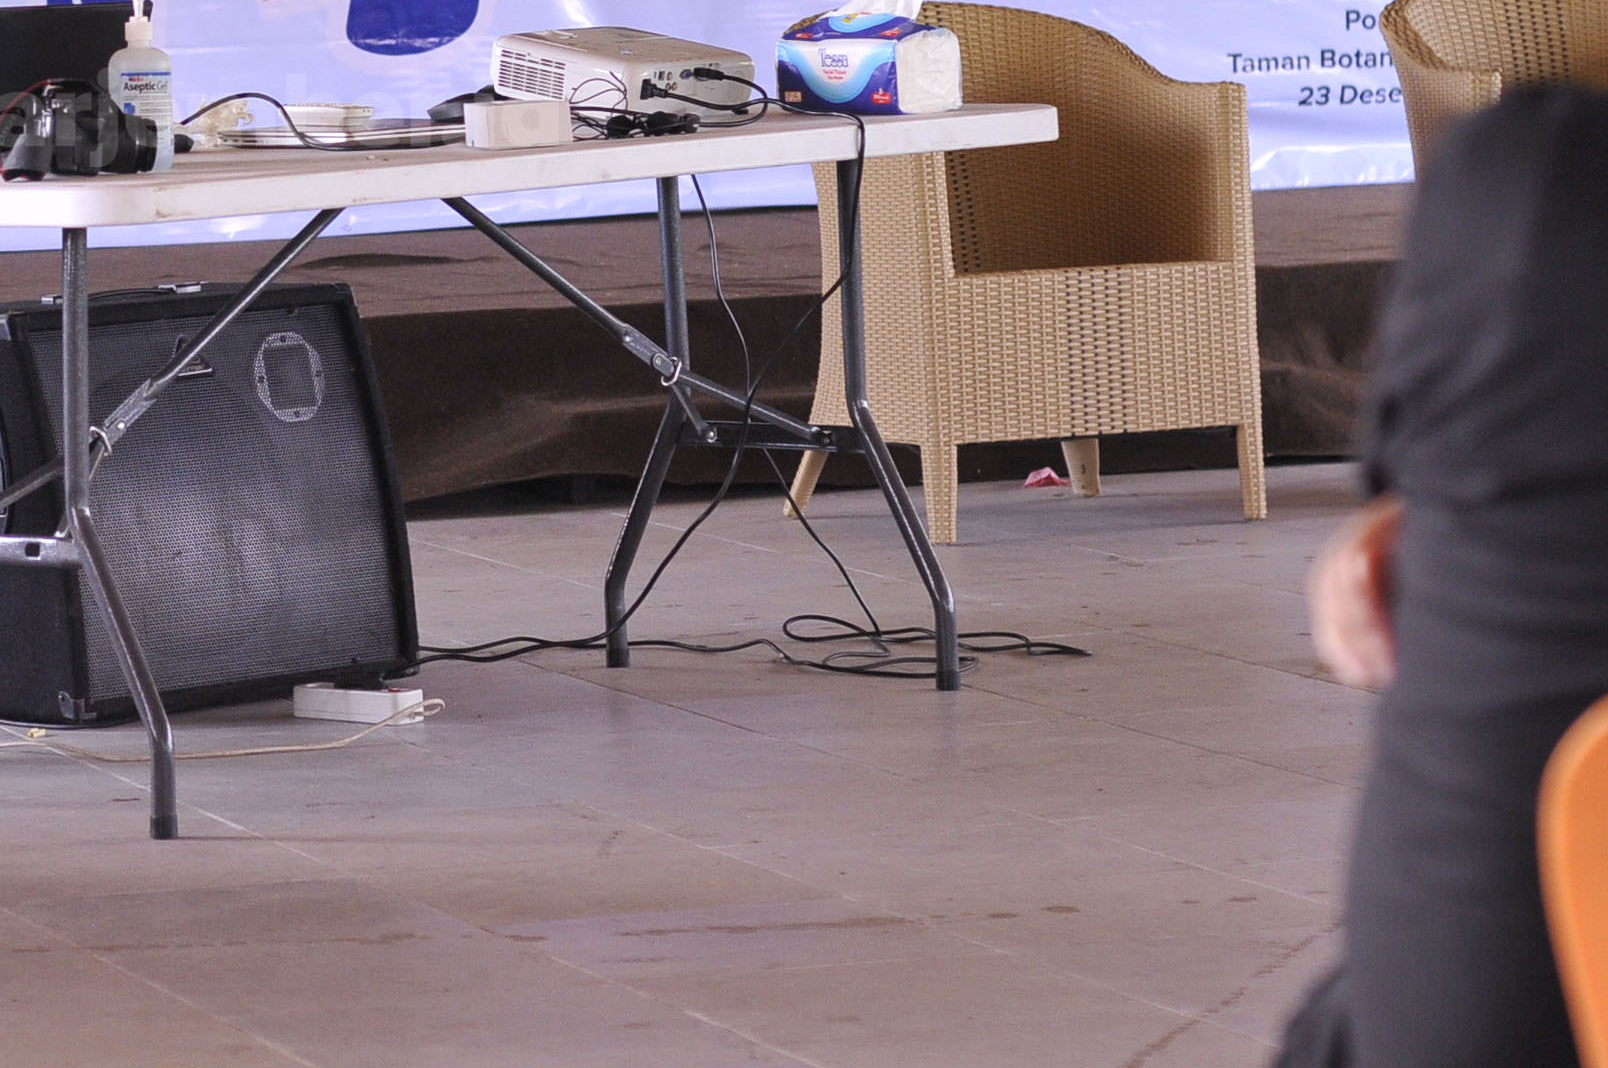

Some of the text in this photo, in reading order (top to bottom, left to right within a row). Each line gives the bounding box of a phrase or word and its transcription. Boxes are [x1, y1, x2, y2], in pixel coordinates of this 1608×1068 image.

[1345, 8, 1380, 31] Po
[1227, 48, 1395, 74] Taman Botan
[123, 81, 156, 93] Aseptic
[1298, 84, 1402, 107] 23 Dese
